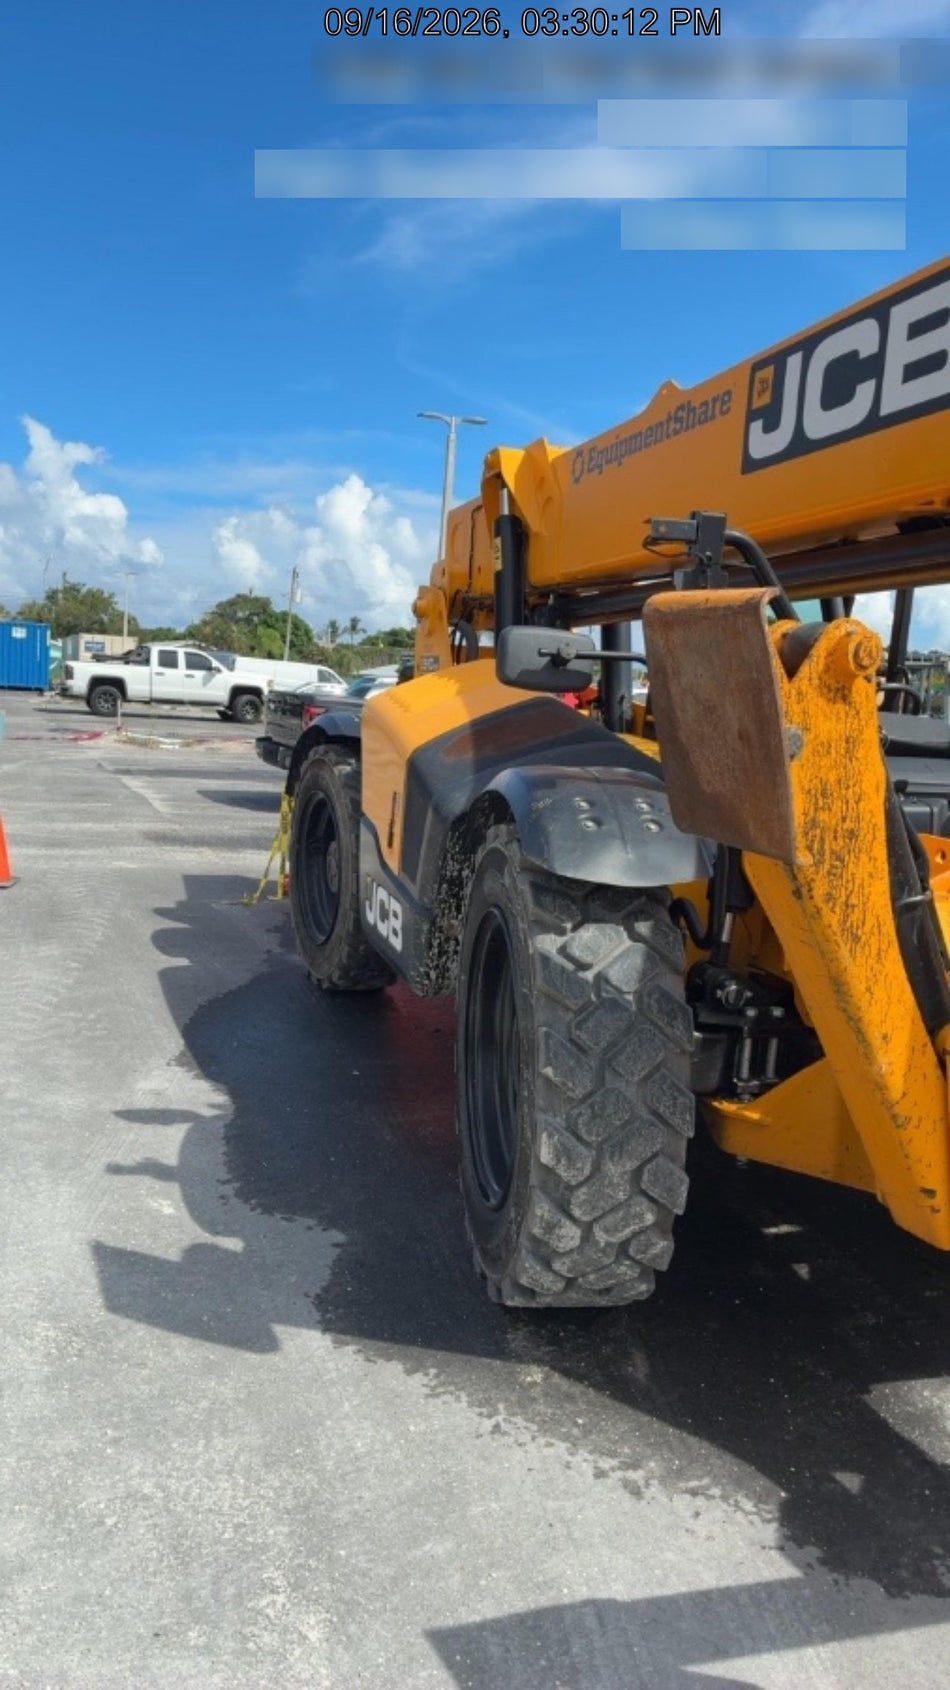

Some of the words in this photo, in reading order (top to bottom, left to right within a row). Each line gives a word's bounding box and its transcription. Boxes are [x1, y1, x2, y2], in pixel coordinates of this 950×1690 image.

[748, 279, 950, 460] JCB
[587, 389, 733, 475] EquipmentShare
[365, 875, 403, 953] JCB
